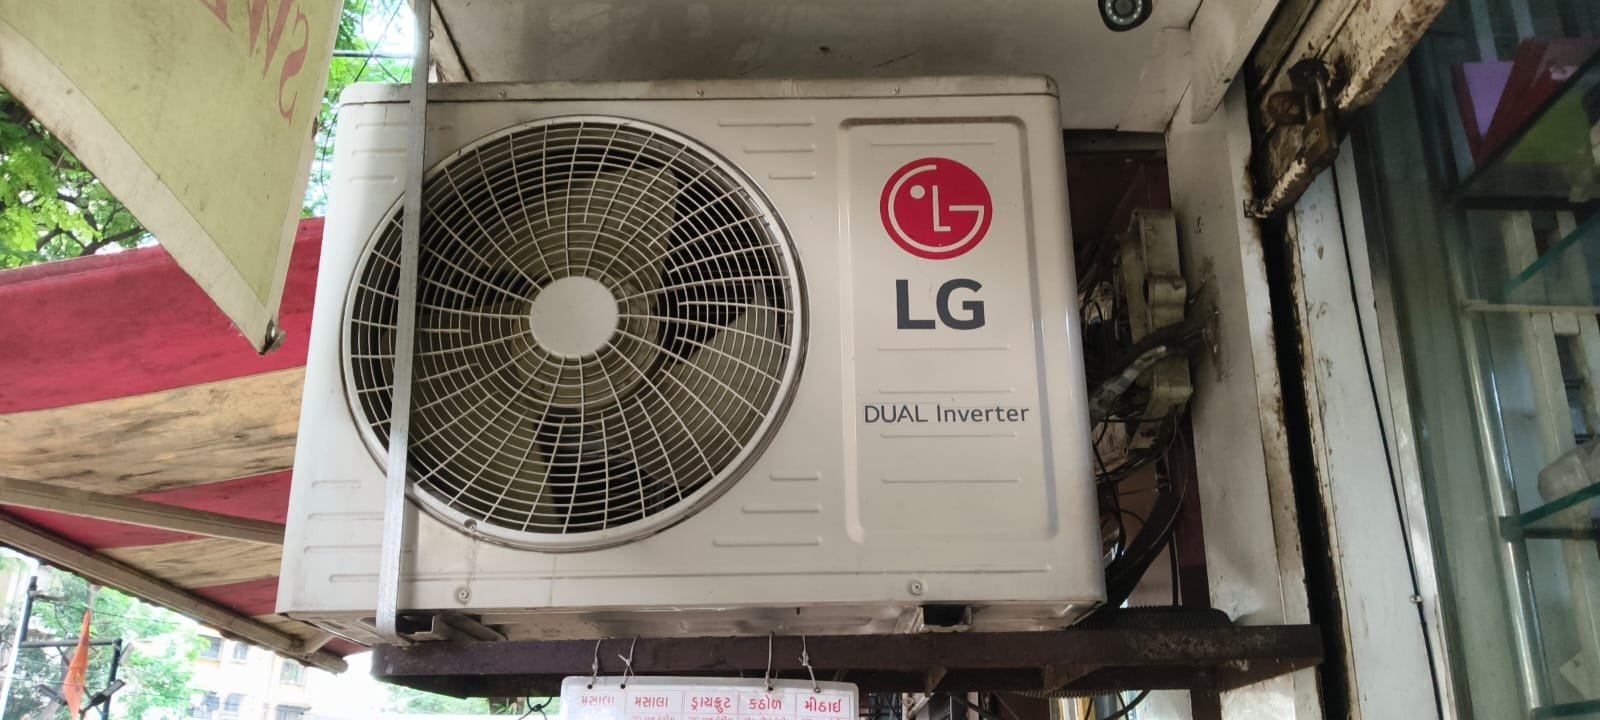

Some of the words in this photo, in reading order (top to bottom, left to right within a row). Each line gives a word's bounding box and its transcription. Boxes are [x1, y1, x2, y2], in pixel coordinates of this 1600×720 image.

[895, 278, 986, 331] LG
[864, 404, 928, 423] DUAL
[936, 404, 1030, 423] Inverter
[634, 696, 669, 708] મસાલા
